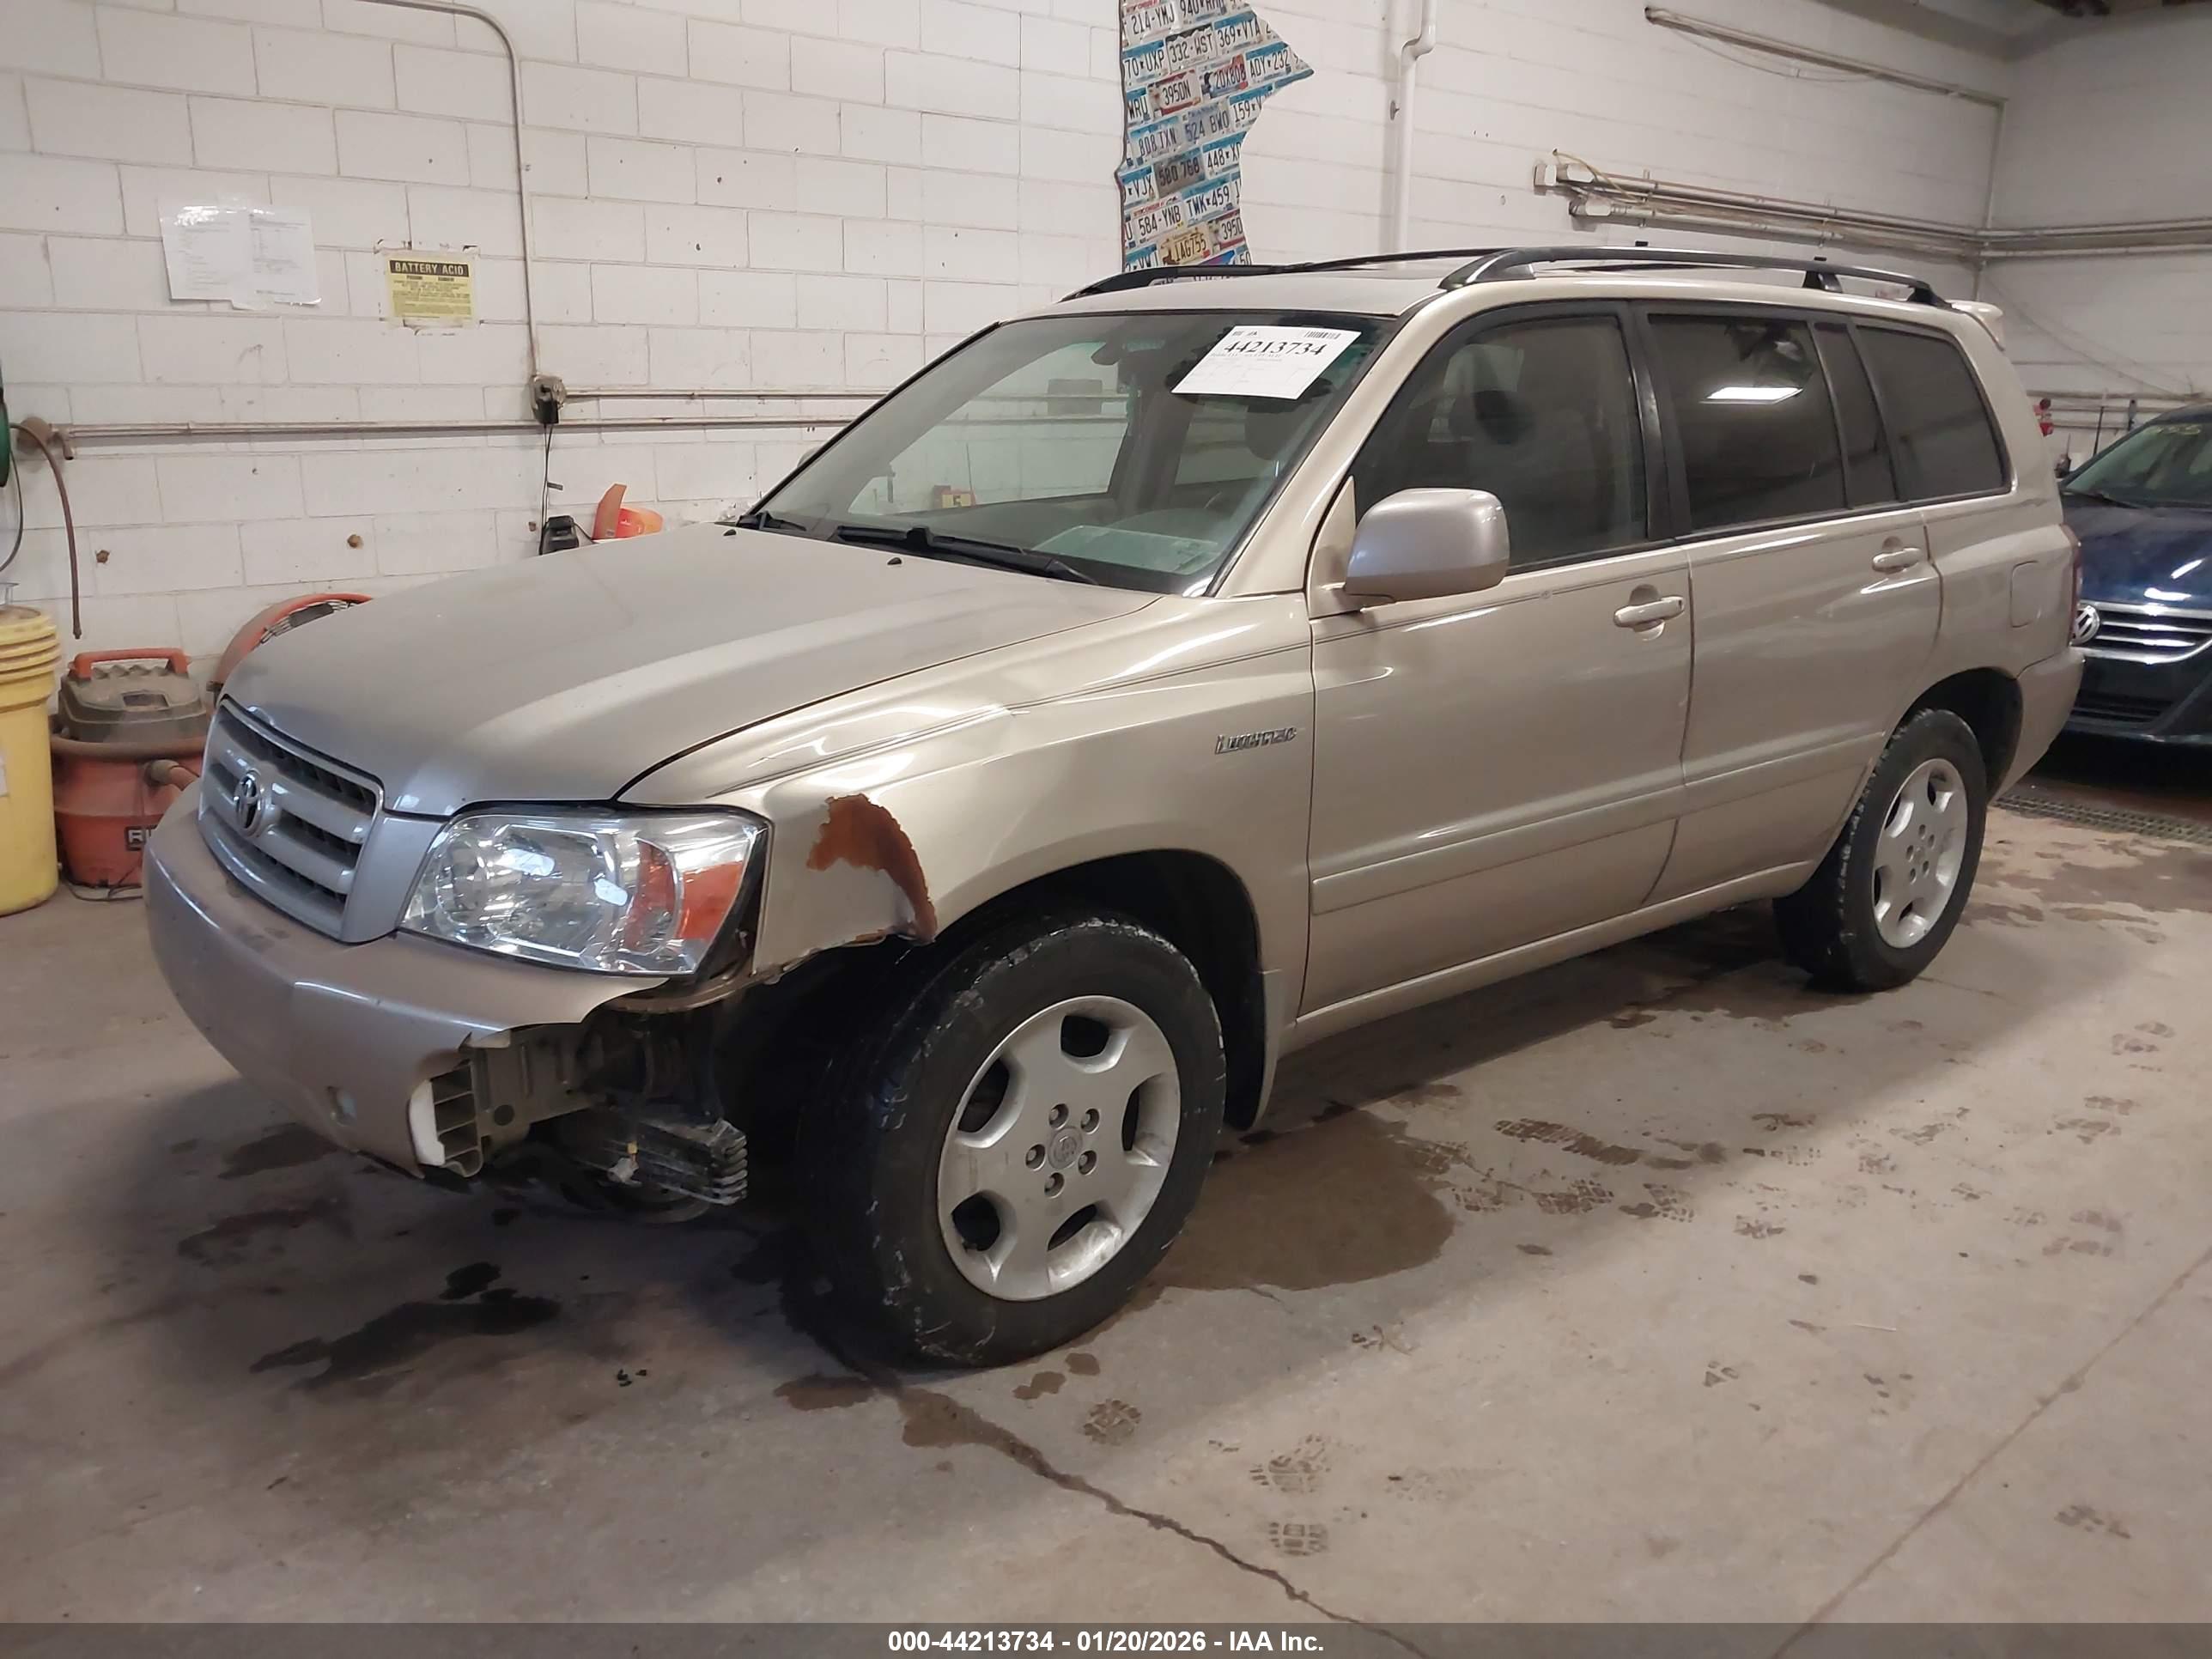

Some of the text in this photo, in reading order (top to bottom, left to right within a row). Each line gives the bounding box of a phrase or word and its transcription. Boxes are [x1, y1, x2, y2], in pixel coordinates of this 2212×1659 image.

[395, 262, 464, 275] BATTERY ACID
[1224, 340, 1328, 356] 44213734
